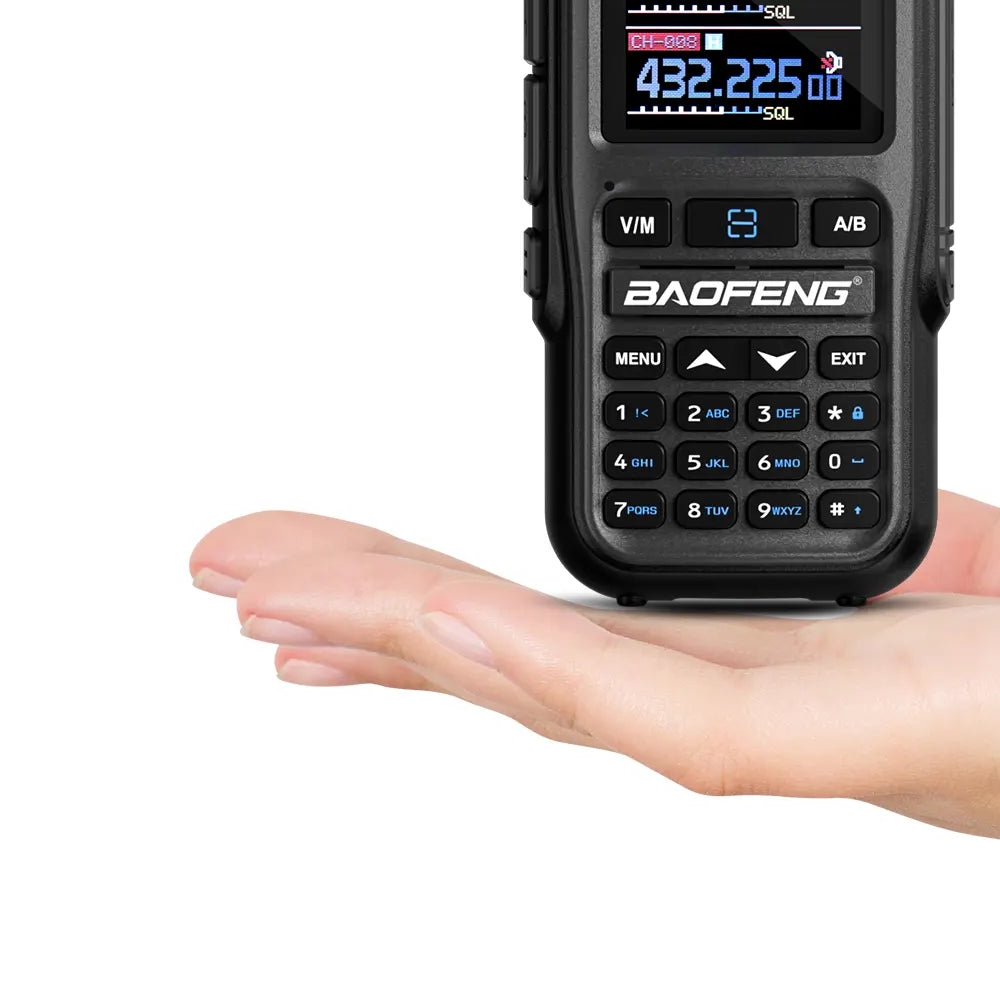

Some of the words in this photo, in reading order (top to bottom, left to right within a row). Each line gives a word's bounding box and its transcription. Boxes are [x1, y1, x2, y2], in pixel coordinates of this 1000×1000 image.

[764, 6, 795, 19] SQL
[631, 35, 697, 49] CH-008
[763, 107, 794, 120] SQL
[620, 216, 654, 234] V/M
[834, 216, 866, 231] A/B
[616, 352, 661, 365] MENU
[832, 352, 866, 365] EXIT
[617, 405, 625, 420] 1
[688, 405, 701, 421] 2
[706, 409, 729, 418] ABC
[758, 406, 771, 422] 3
[777, 409, 800, 418] DEF
[614, 454, 627, 469] 4
[632, 458, 653, 467] GHI
[688, 455, 701, 470] 5
[706, 459, 729, 467] JKL
[758, 455, 771, 470] 6
[775, 459, 800, 467] MNO
[829, 454, 840, 469] 0
[615, 502, 627, 517] 7
[627, 506, 657, 515] PQRS
[688, 503, 701, 518] 8
[705, 507, 729, 515] TUV
[758, 503, 771, 518] 9
[772, 507, 801, 515] WXYZ
